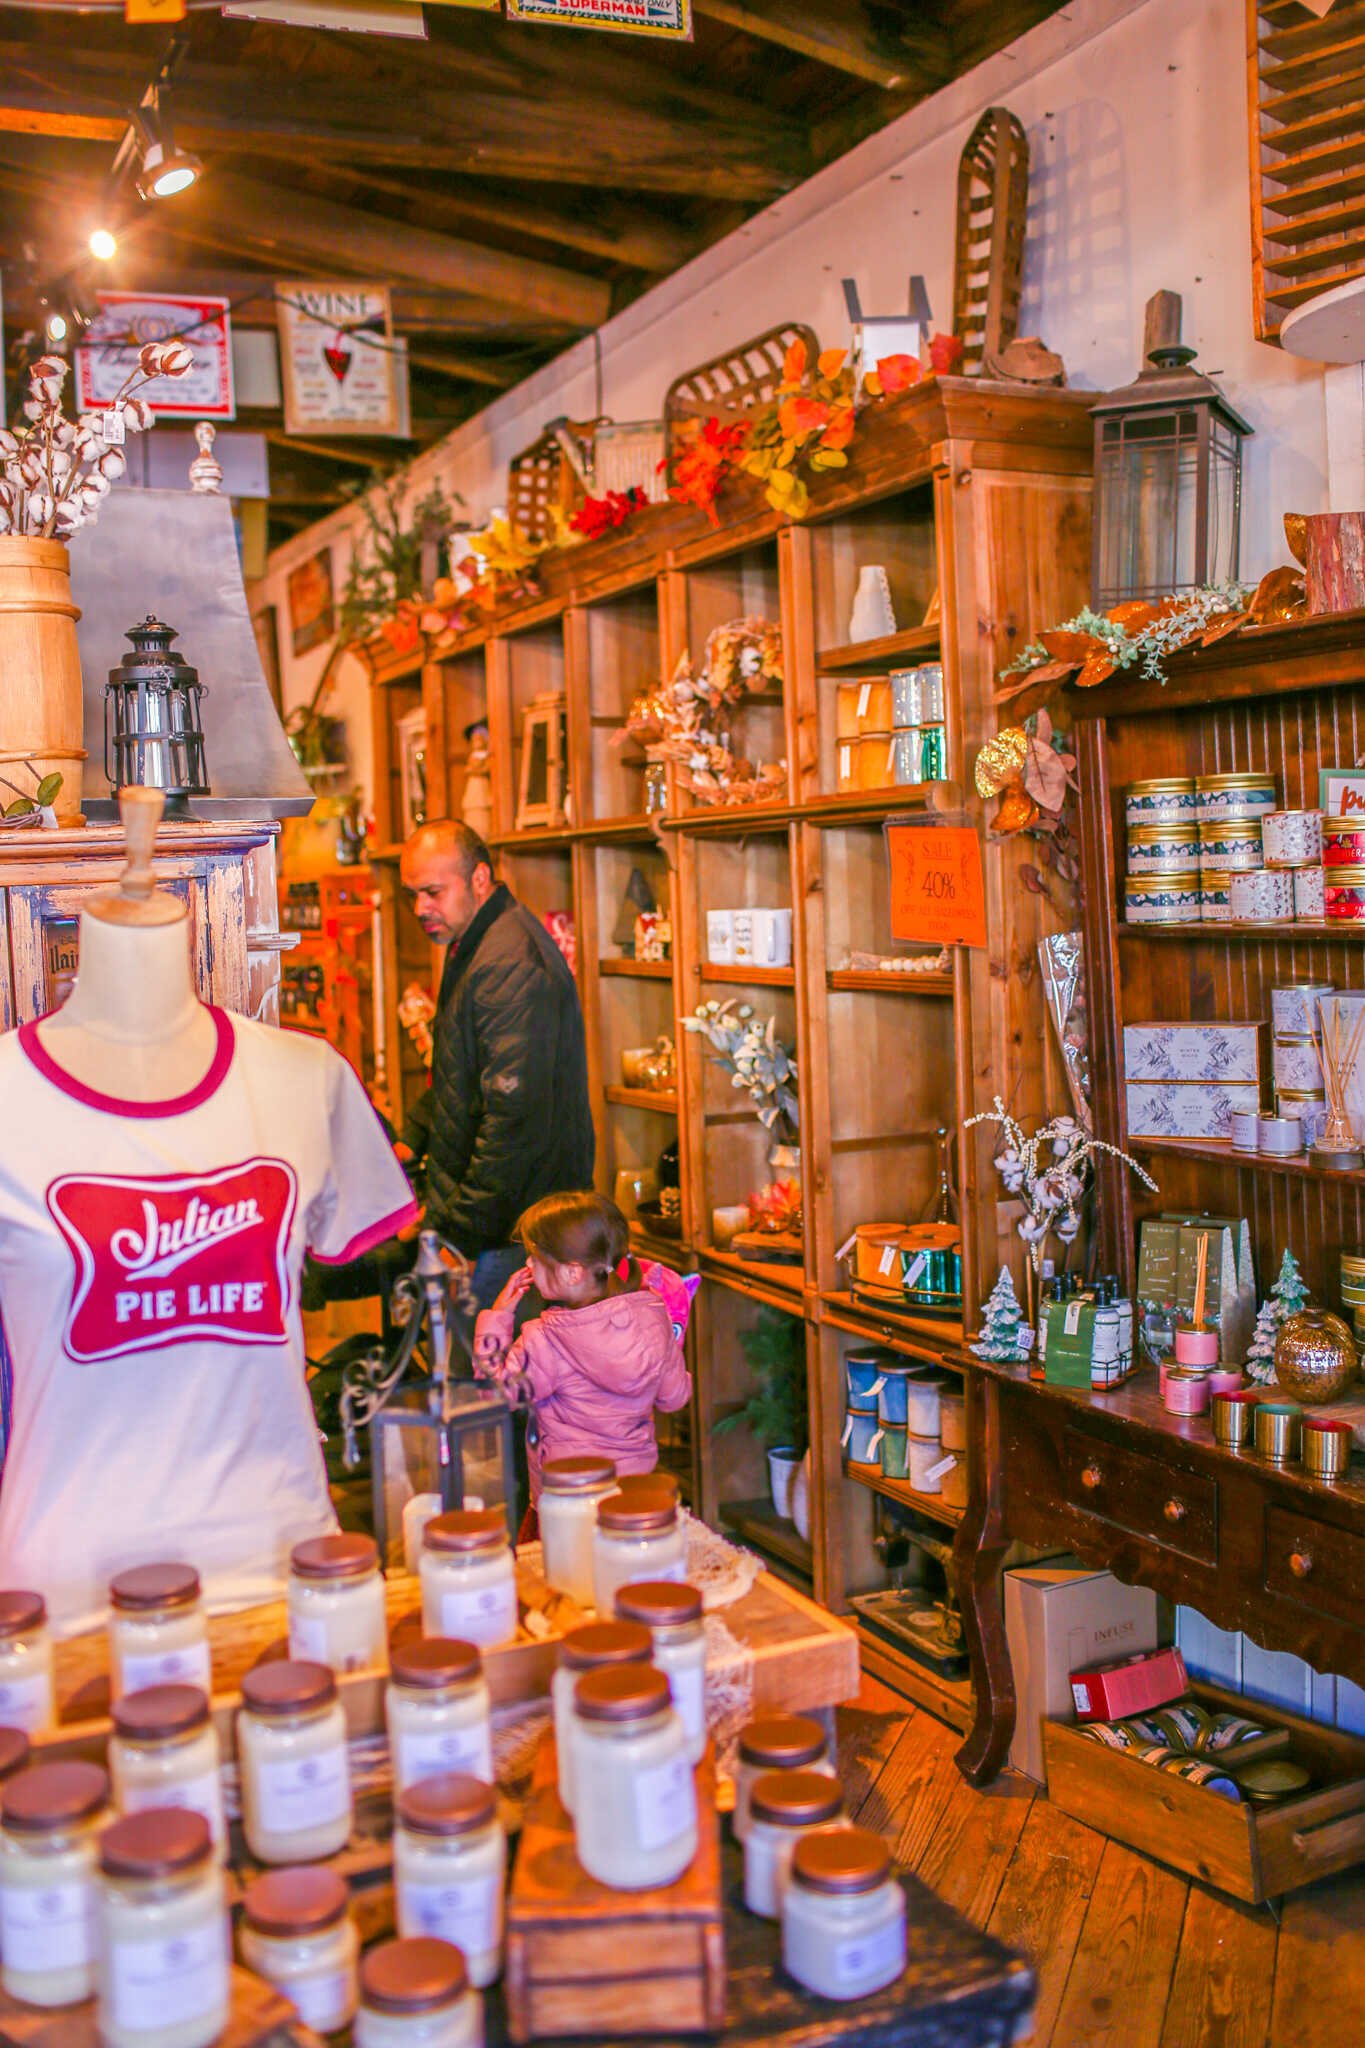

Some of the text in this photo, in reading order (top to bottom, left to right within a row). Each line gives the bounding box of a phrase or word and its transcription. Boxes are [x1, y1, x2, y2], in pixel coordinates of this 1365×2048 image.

[558, 0, 646, 17] SUPERMAN
[294, 290, 373, 317] WINE
[921, 871, 956, 899] 40%
[110, 1196, 264, 1271] Julian
[115, 1281, 264, 1323] PIE LIFE
